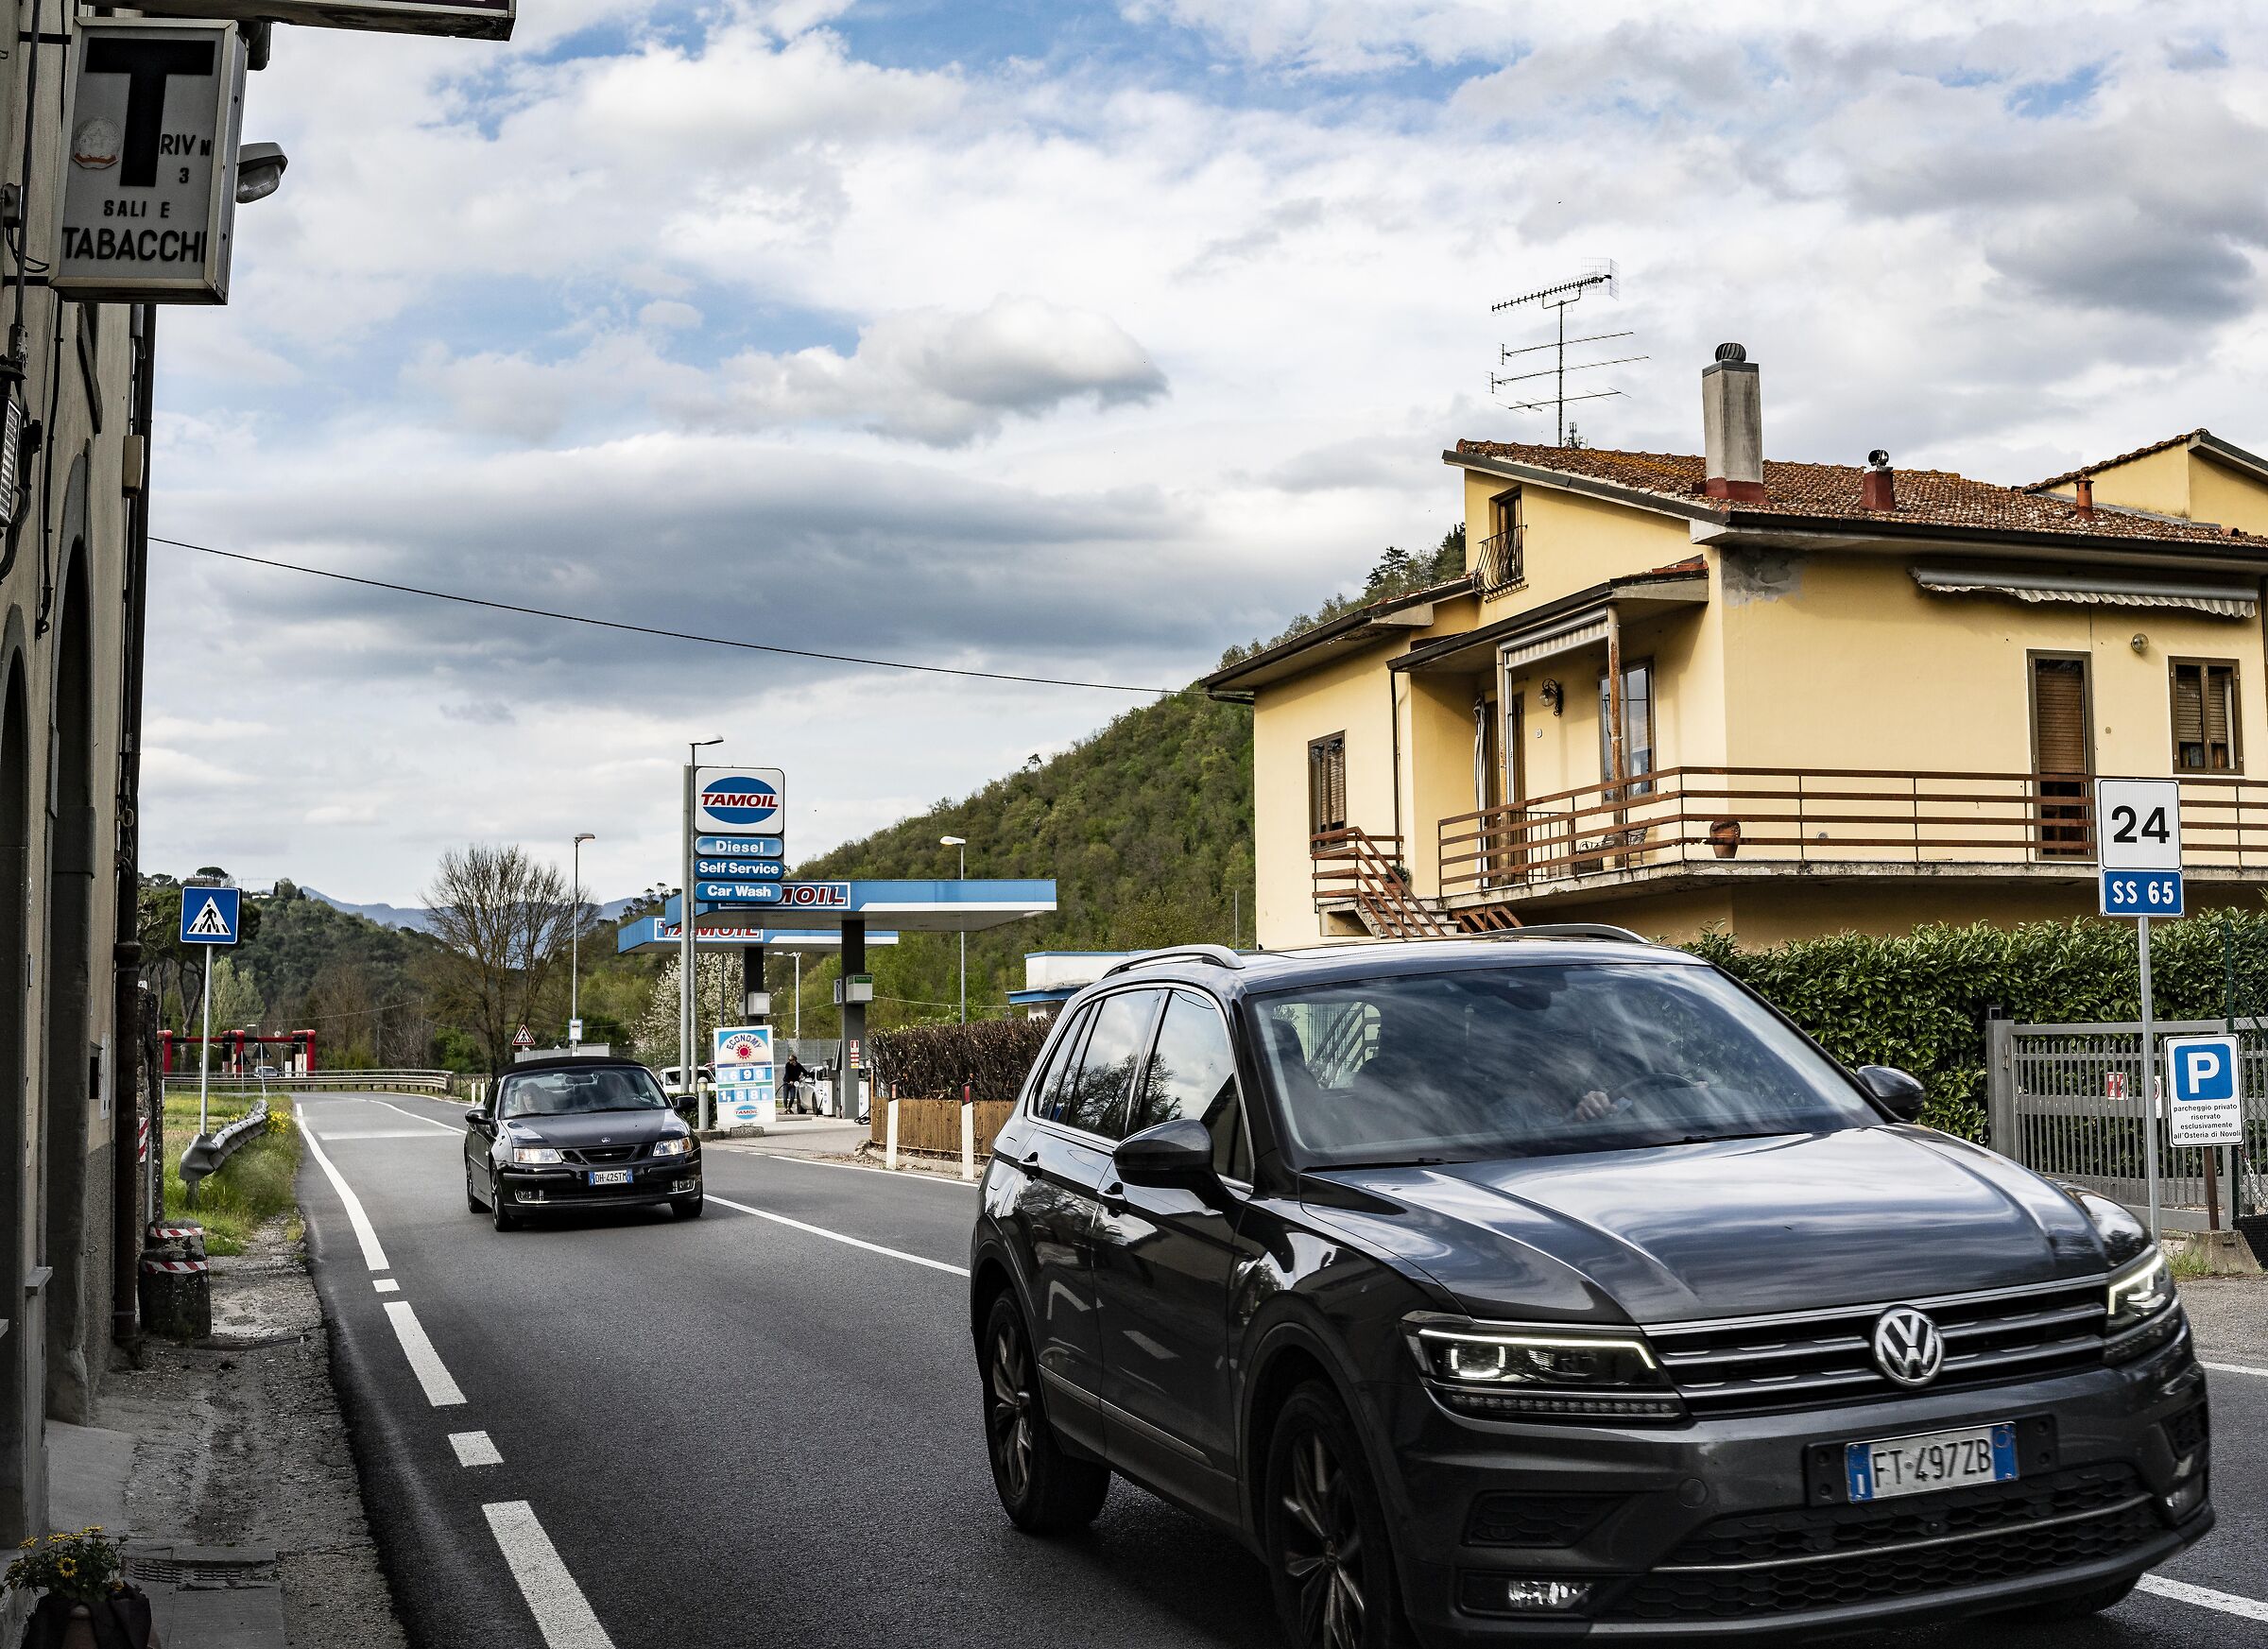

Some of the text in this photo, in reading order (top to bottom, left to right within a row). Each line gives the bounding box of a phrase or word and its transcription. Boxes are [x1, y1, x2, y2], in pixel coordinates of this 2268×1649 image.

[85, 38, 215, 187] T
[160, 133, 197, 155] RIV
[179, 167, 190, 183] 3
[103, 199, 170, 218] SALI E
[61, 227, 207, 263] TABACCHI
[701, 793, 779, 808] TAMOIL
[2111, 804, 2171, 844] 24
[715, 840, 765, 853] Diesel
[699, 861, 780, 875] Self Service
[707, 885, 772, 898] Car Wash
[2112, 880, 2174, 904] SS 65
[726, 1034, 763, 1050] ECONOMY
[2187, 1052, 2221, 1094] P
[2174, 1103, 2238, 1112] parcheggio privato
[2180, 1122, 2233, 1130] esclusivamente
[2174, 1131, 2209, 1140] all'Osteria
[2220, 1129, 2242, 1138] Novoli
